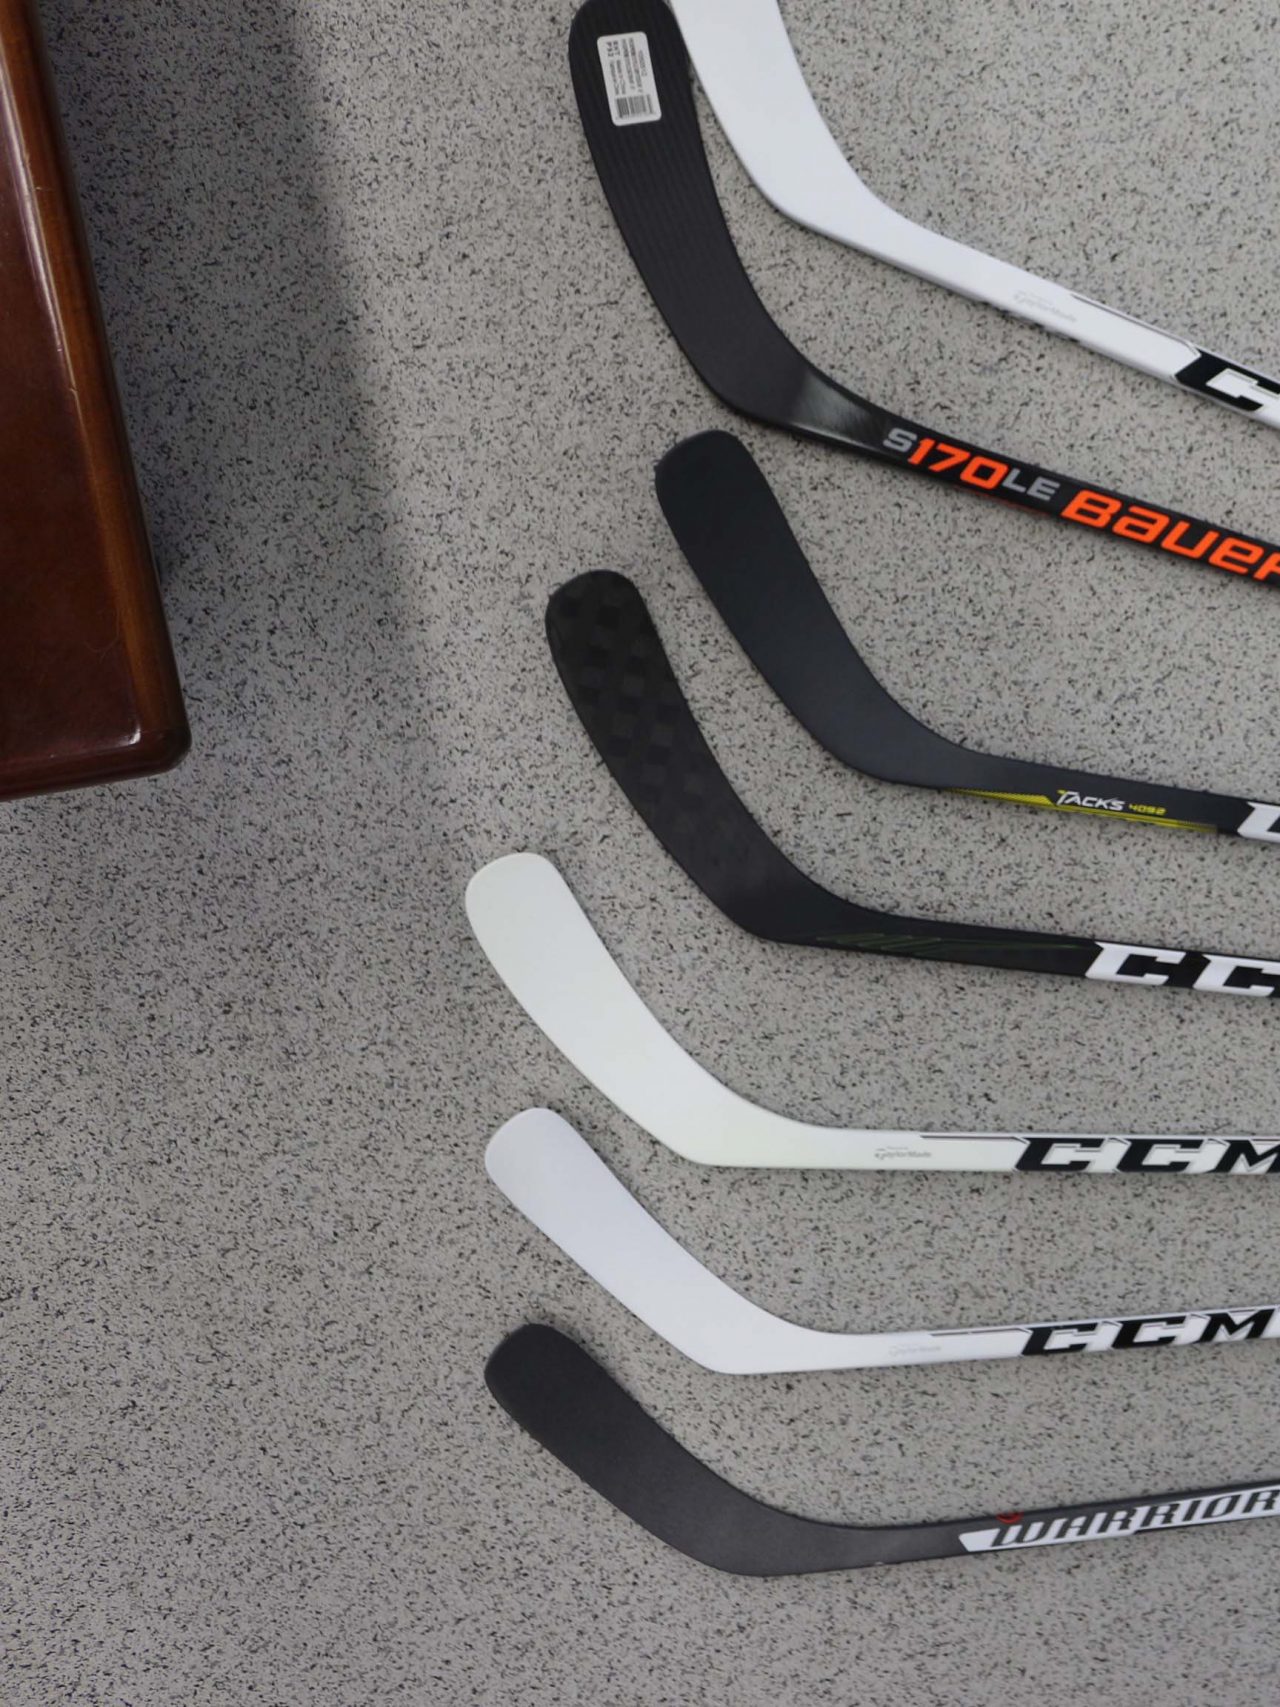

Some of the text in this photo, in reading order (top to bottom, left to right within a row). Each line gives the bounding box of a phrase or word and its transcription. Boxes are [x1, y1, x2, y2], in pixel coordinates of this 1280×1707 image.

[1057, 789, 1125, 812] TACKS
[1022, 1308, 1276, 1355] CCM
[991, 1489, 1280, 1547] WARRIOR
